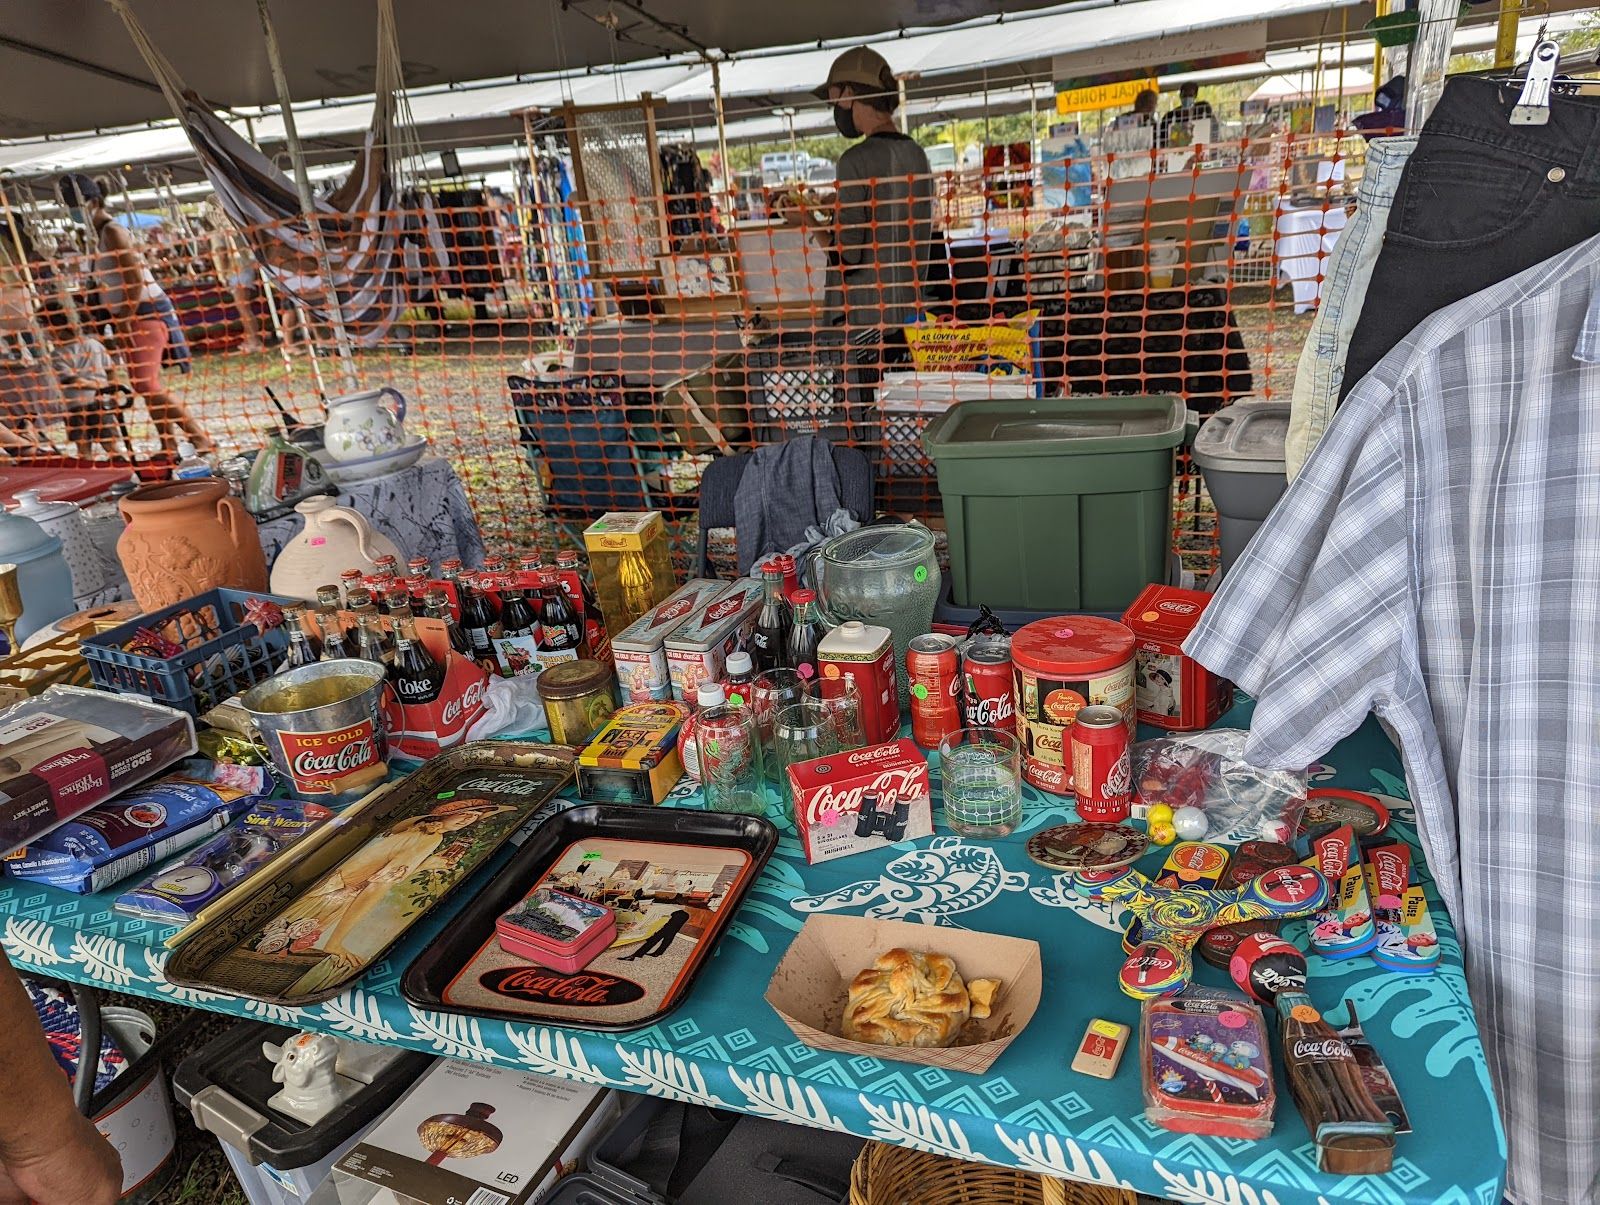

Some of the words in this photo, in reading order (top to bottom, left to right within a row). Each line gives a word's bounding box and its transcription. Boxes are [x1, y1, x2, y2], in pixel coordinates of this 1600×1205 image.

[561, 580, 571, 593] 6
[1159, 601, 1197, 614] Coca-Cola
[398, 678, 433, 695] Coke
[1051, 702, 1080, 712] Coca-Cola
[296, 738, 323, 747] ICE
[327, 728, 364, 745] COLD
[294, 736, 373, 777] Coca-Cola
[848, 743, 901, 764] Coca-Cola
[1029, 764, 1061, 784] Coca-Cola
[58, 773, 93, 798] Homes
[75, 777, 103, 796] Better
[456, 777, 544, 796] Coca-Cola
[806, 765, 926, 825] Coca-Cola
[33, 806, 50, 818] Twin
[244, 813, 271, 828] Sink
[1188, 846, 1209, 870] Coca-Cola
[1321, 838, 1345, 878] Coca-Cola
[1274, 868, 1306, 895] Coca-Cola
[1376, 851, 1403, 892] Coca-Cola
[1344, 874, 1362, 901] Pause
[1406, 896, 1425, 918] Pause
[1124, 956, 1173, 971] Coca-Cola
[497, 969, 622, 1003] Coca-Cola
[1183, 1001, 1219, 1010] Coca-Cola
[1293, 1039, 1354, 1059] Coca-Cola
[497, 1171, 519, 1184] LED
